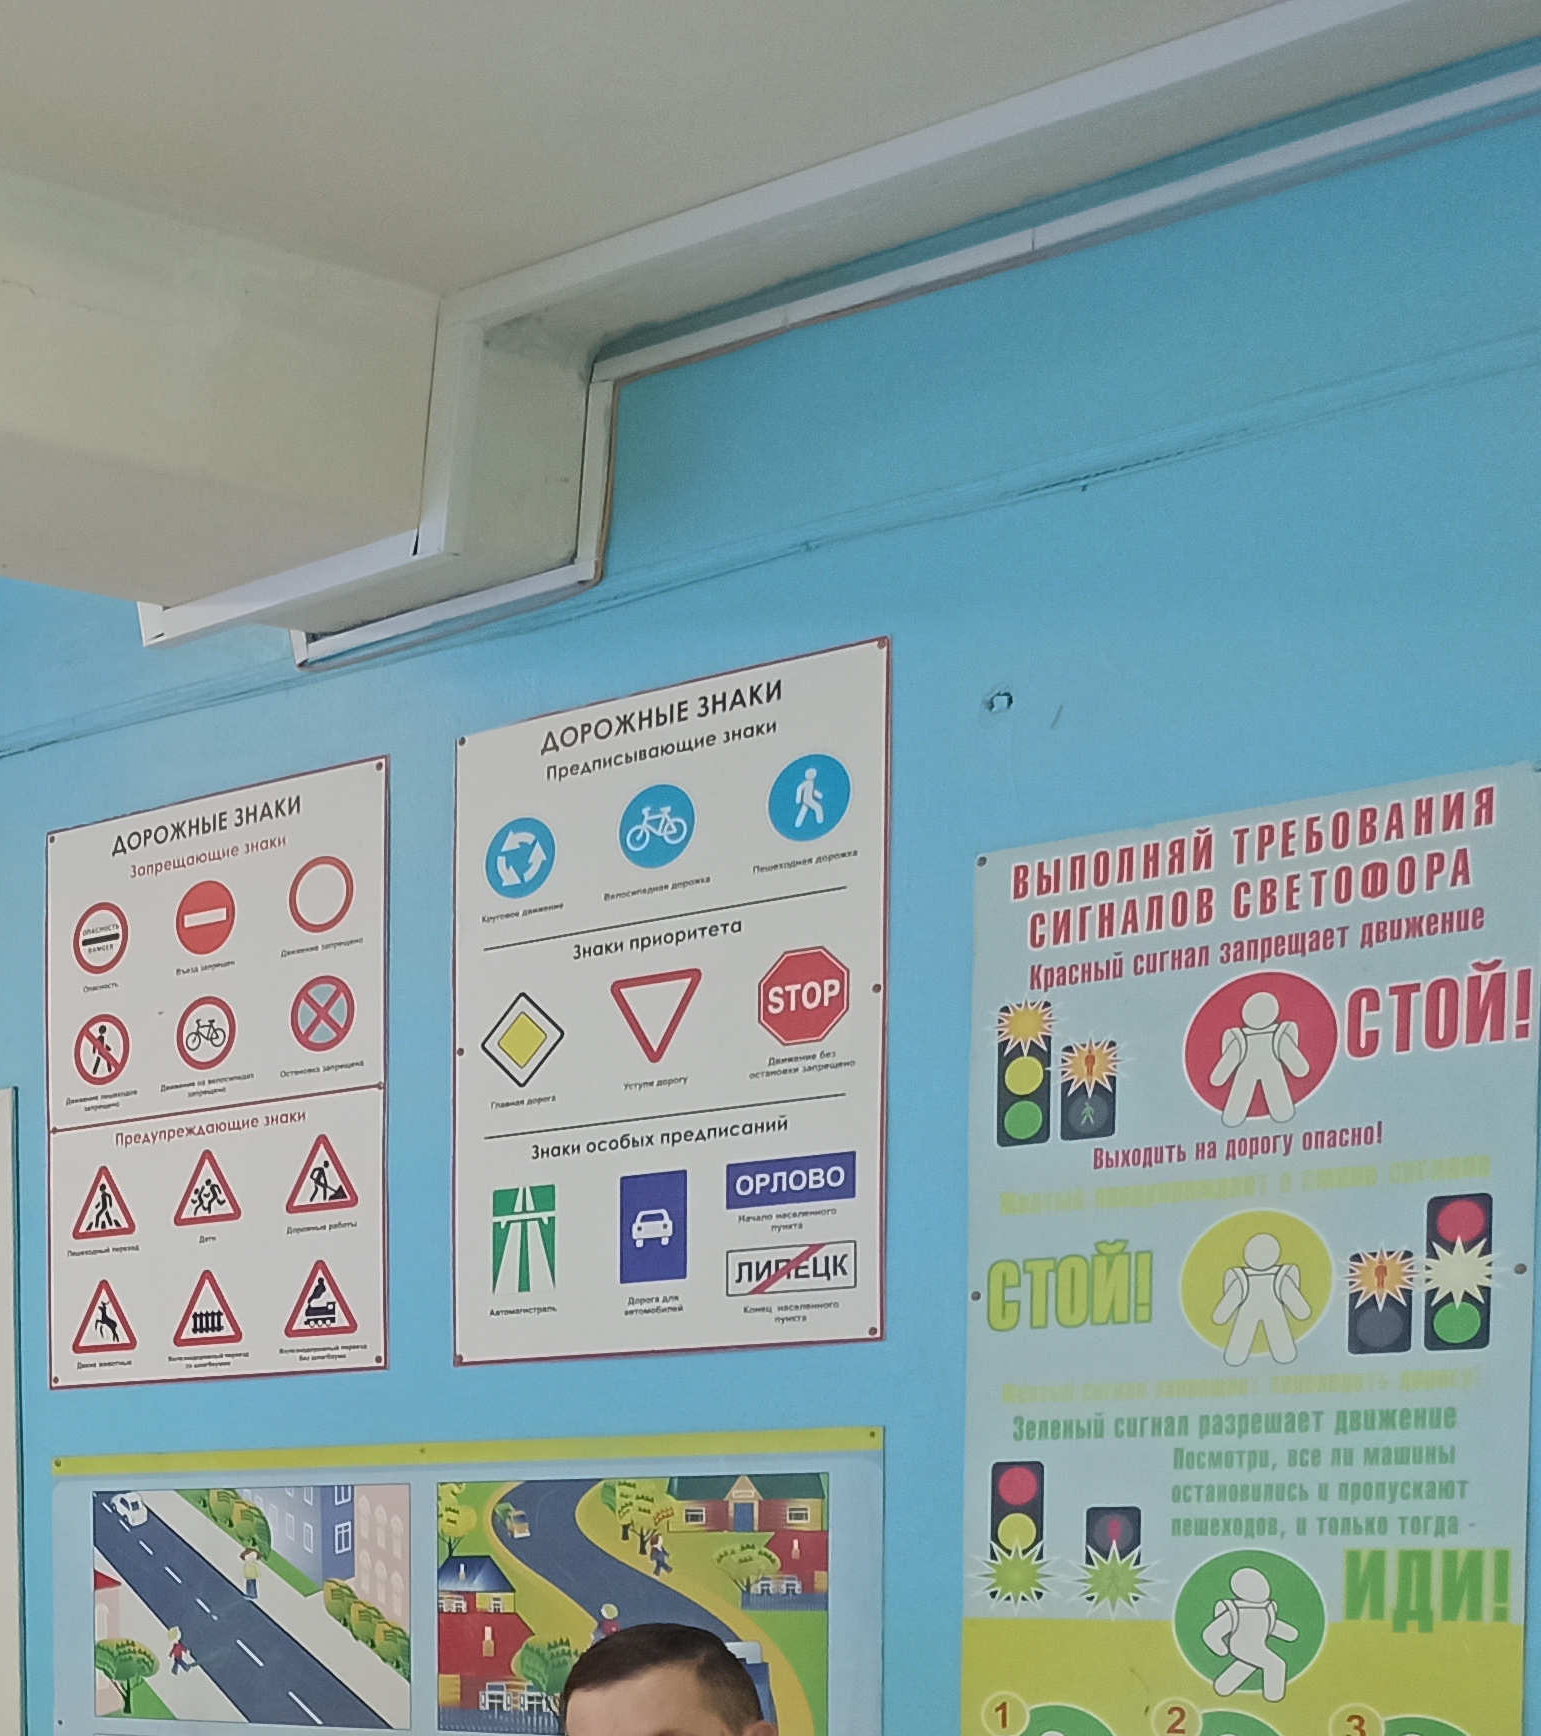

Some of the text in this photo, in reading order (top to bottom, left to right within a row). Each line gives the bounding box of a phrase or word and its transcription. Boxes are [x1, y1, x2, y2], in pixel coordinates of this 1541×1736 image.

[539, 679, 783, 755] ДОРОЖНЫЕ ЗНАКИ
[545, 720, 778, 781] Предписывающие знаки
[111, 795, 301, 857] ДОРОЖНЫЕ ЗНАКИ
[1011, 785, 1497, 901] ВЫПОЛНЯЙ ТРЕБОВАНИЯ
[129, 835, 287, 879] Запрещающие знаки
[1028, 846, 1472, 949] СИГНАЛОВ СВЕТОФОРА
[572, 919, 742, 961] Знаки приоритета
[1030, 906, 1486, 992] Красный сигнал запрещает движение
[766, 978, 841, 1015] STOP
[1344, 957, 1533, 1059] СТОЙ!
[115, 1109, 306, 1147] Предупреждающие знаки
[530, 1113, 789, 1161] Знаки особых предписаний
[1093, 1121, 1383, 1171] Выходить на дорогу опасно!
[735, 1165, 846, 1197] ОРЛОВО
[734, 1252, 849, 1285] ЛИПЕЦК
[986, 1238, 1154, 1332] СТОЙ!
[1012, 1405, 1458, 1442] Зеленый сигнал разрешает движение
[1172, 1443, 1456, 1473] Посмотри, все ли машины
[1171, 1478, 1469, 1504] остановились и пропускают
[1171, 1515, 1285, 1540] пешеходов,
[1295, 1515, 1307, 1535] и
[1318, 1514, 1388, 1535] только
[1399, 1513, 1460, 1537] тогда
[1343, 1547, 1511, 1633] ИДИ!
[994, 1702, 1009, 1730] 1
[1165, 1706, 1187, 1736] 2
